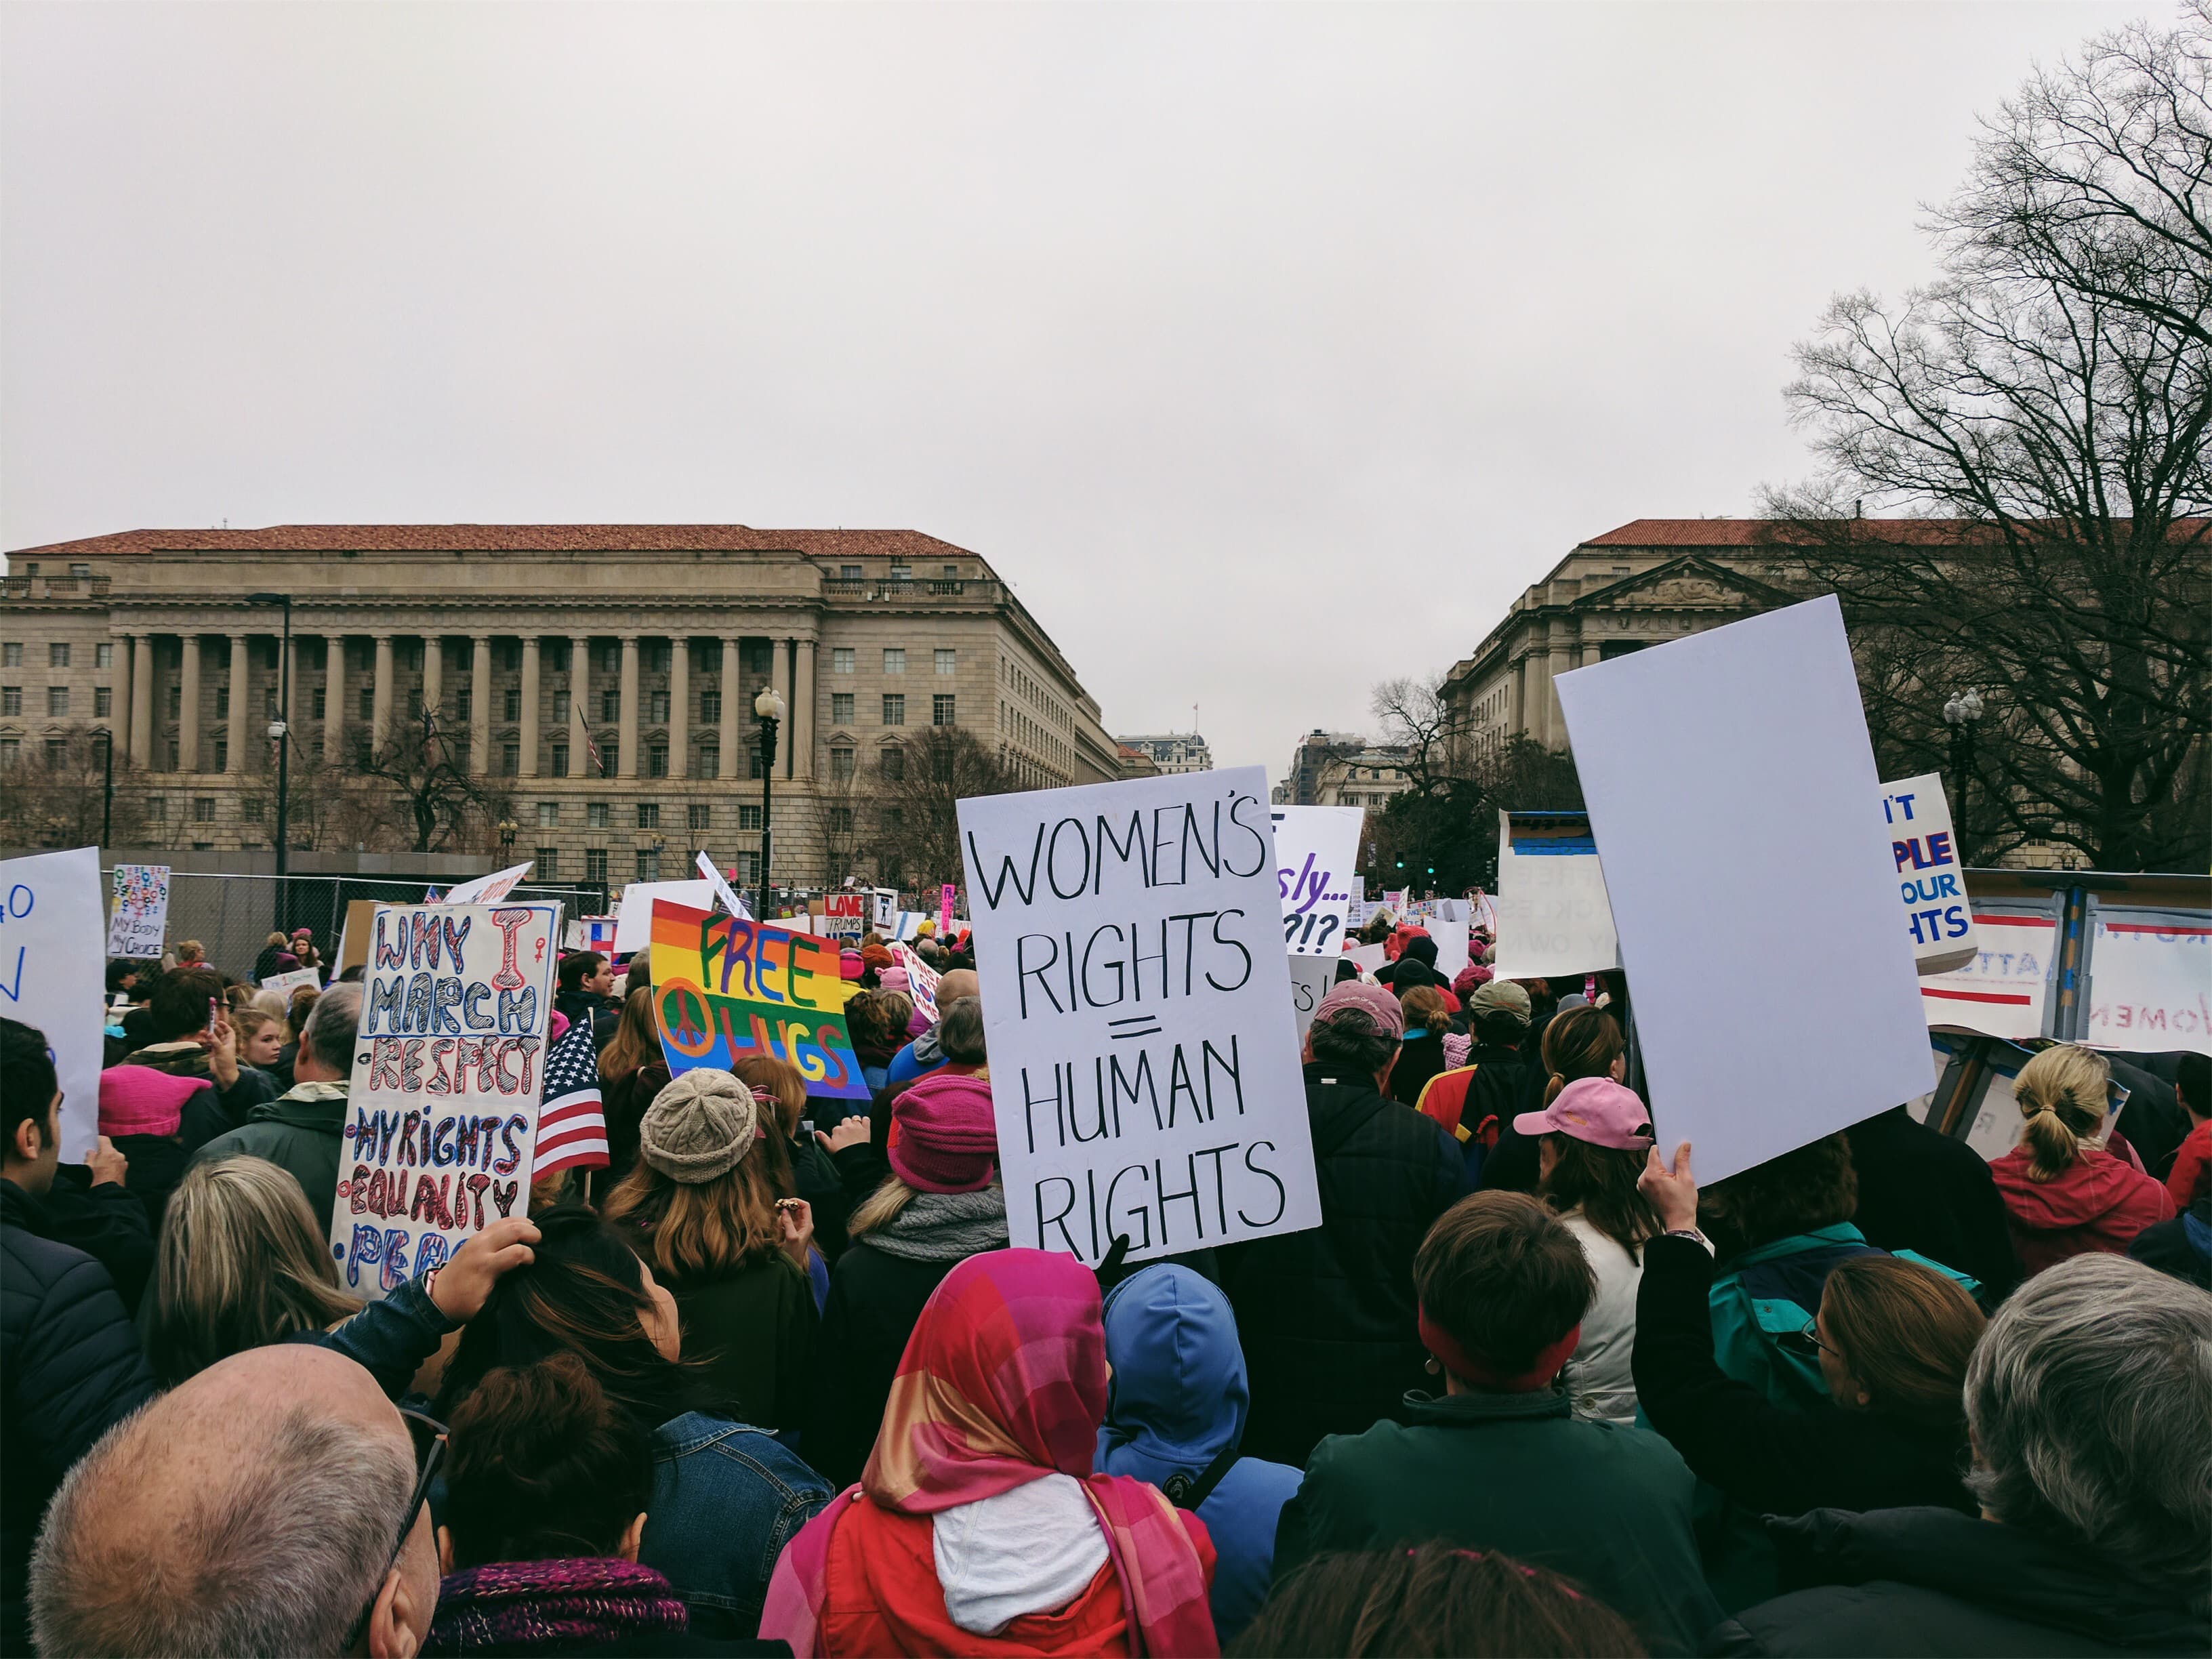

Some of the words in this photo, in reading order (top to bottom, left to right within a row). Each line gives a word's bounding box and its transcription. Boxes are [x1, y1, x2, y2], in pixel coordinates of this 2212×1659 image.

[968, 789, 1267, 911] WOMEN'S
[824, 895, 864, 917] LOVE
[1900, 874, 1961, 905] OUR
[111, 918, 130, 932] MY
[131, 920, 161, 937] BODY
[125, 937, 161, 955] CHOICE
[375, 912, 472, 975] WHY
[491, 908, 533, 991] I
[825, 918, 861, 933] TRUMPS
[700, 914, 819, 1008] FREE
[1017, 909, 1252, 1020] RIGHTS
[369, 972, 536, 1033] MARCH
[370, 1035, 541, 1096] RESPECT
[720, 1006, 849, 1089] HUGS
[1021, 1035, 1244, 1153] HUMAN
[1035, 1141, 1286, 1263] RIGHTS
[347, 1223, 470, 1293] PEA
